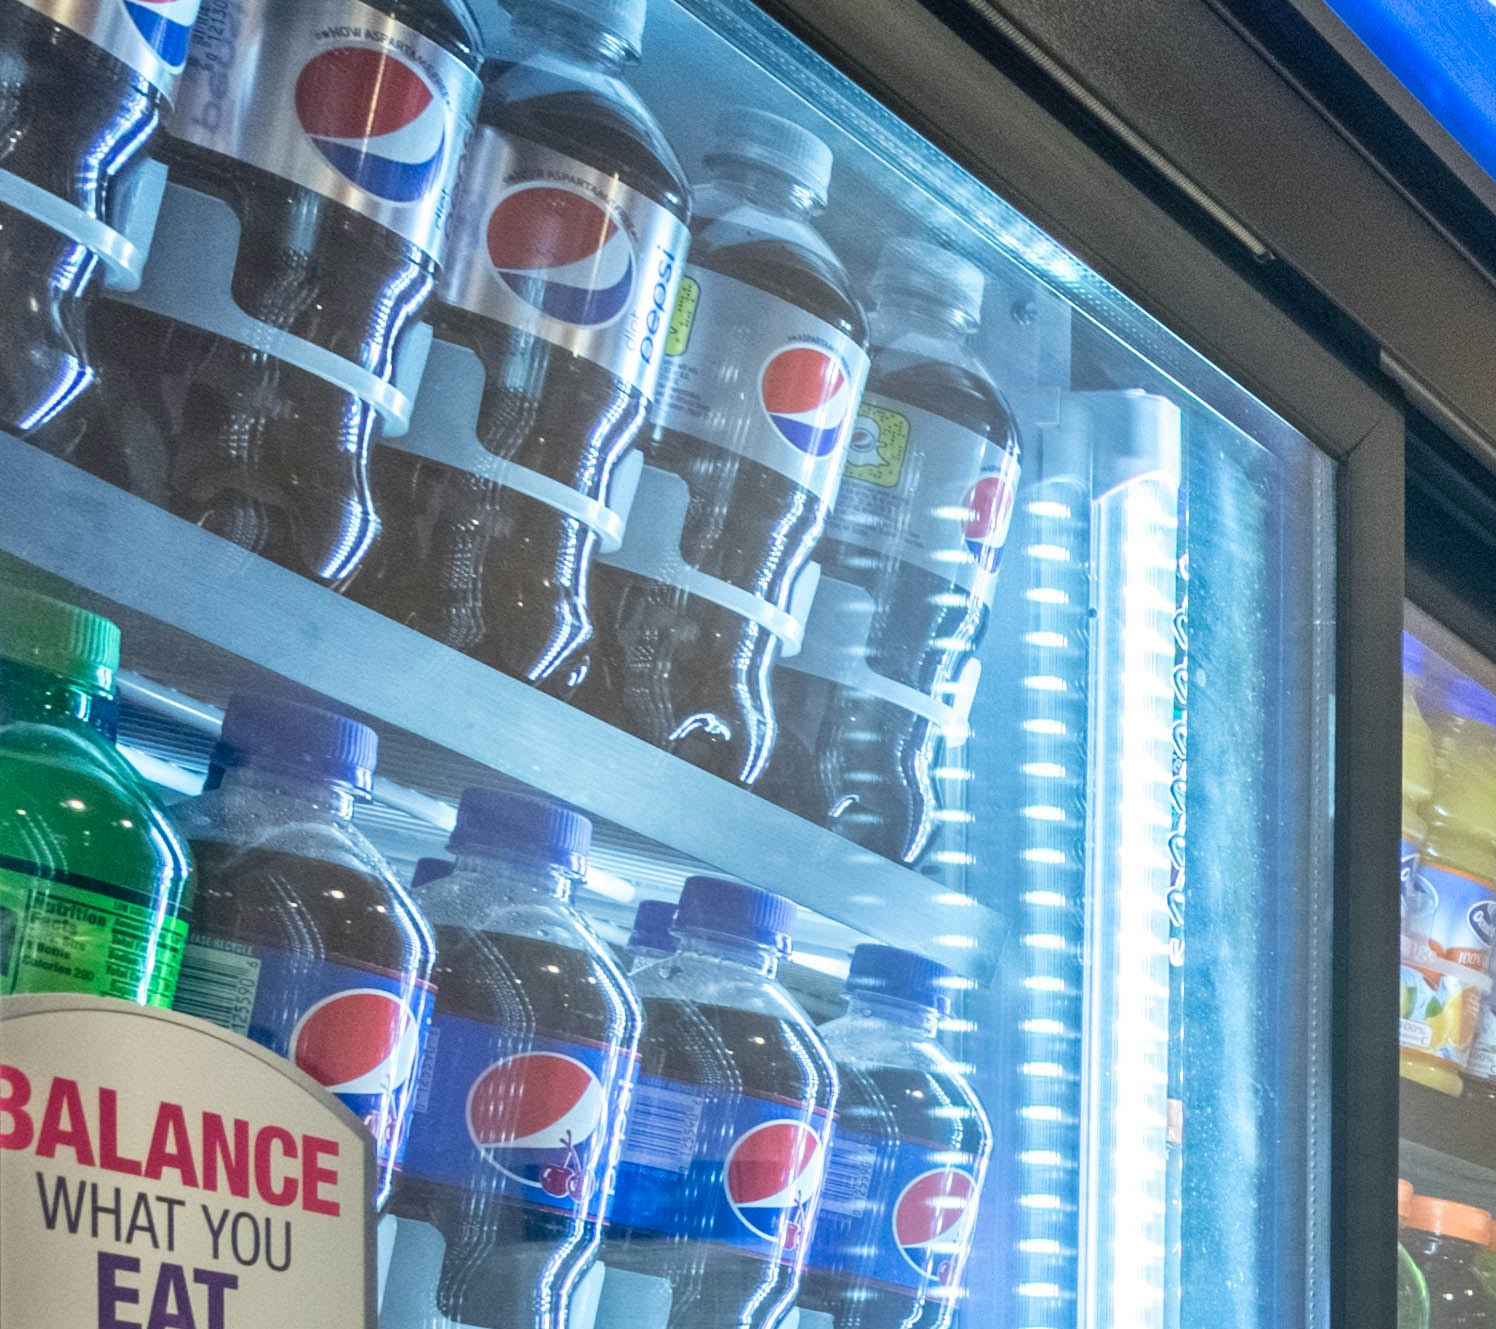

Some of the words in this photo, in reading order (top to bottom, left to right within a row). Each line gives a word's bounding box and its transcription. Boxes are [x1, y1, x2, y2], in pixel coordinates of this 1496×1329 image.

[640, 246, 674, 366] pepsi
[0, 1064, 341, 1218] BALANCE
[36, 1171, 186, 1253] WHAT
[201, 1203, 293, 1272] YOU
